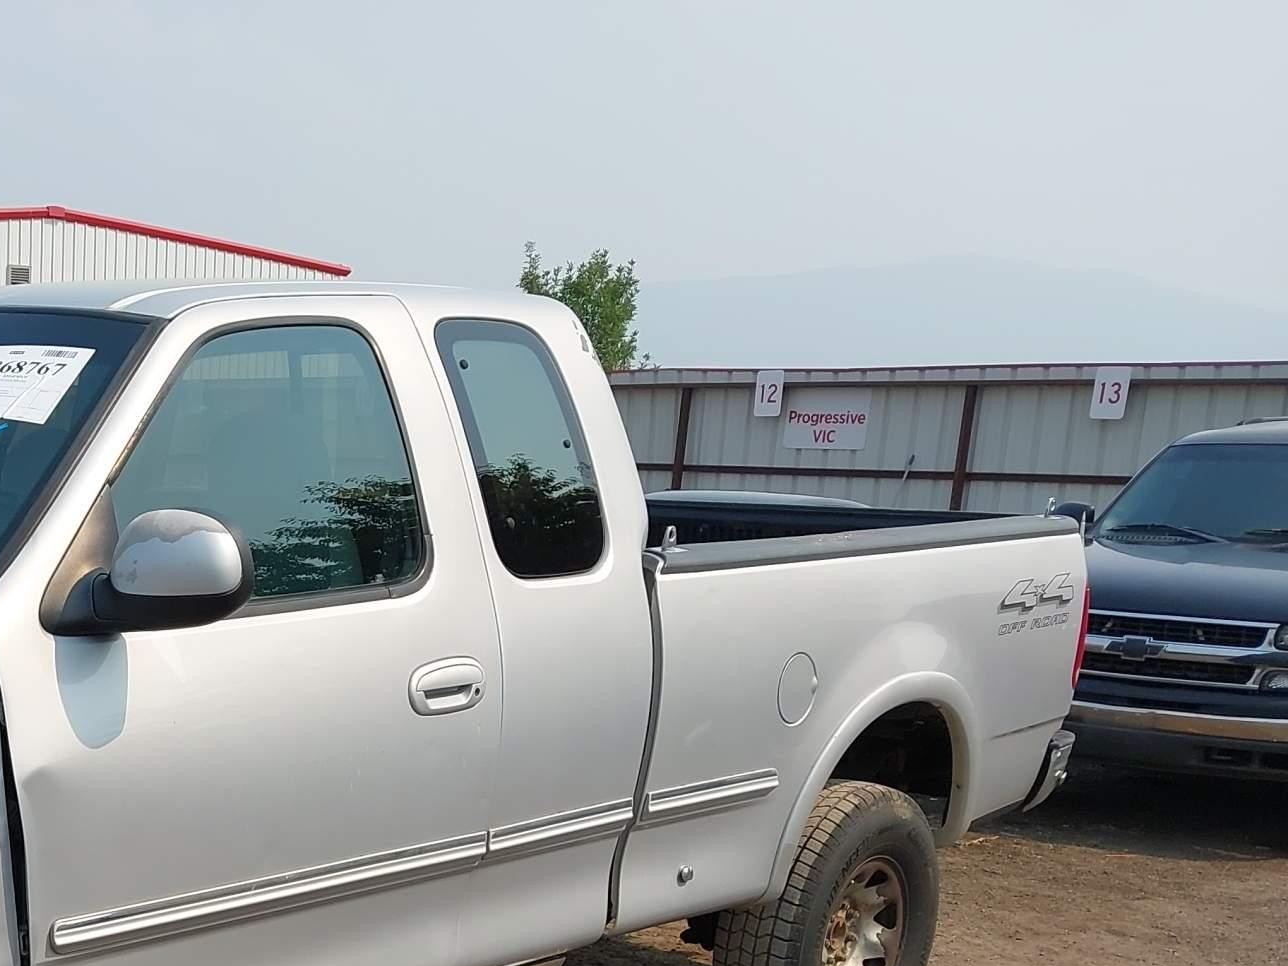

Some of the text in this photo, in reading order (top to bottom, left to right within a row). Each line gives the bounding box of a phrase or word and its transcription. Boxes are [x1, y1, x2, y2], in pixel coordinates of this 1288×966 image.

[760, 384, 778, 403] 12
[1099, 382, 1121, 404] 13
[788, 410, 866, 426] Progressive
[813, 430, 837, 443] VIC
